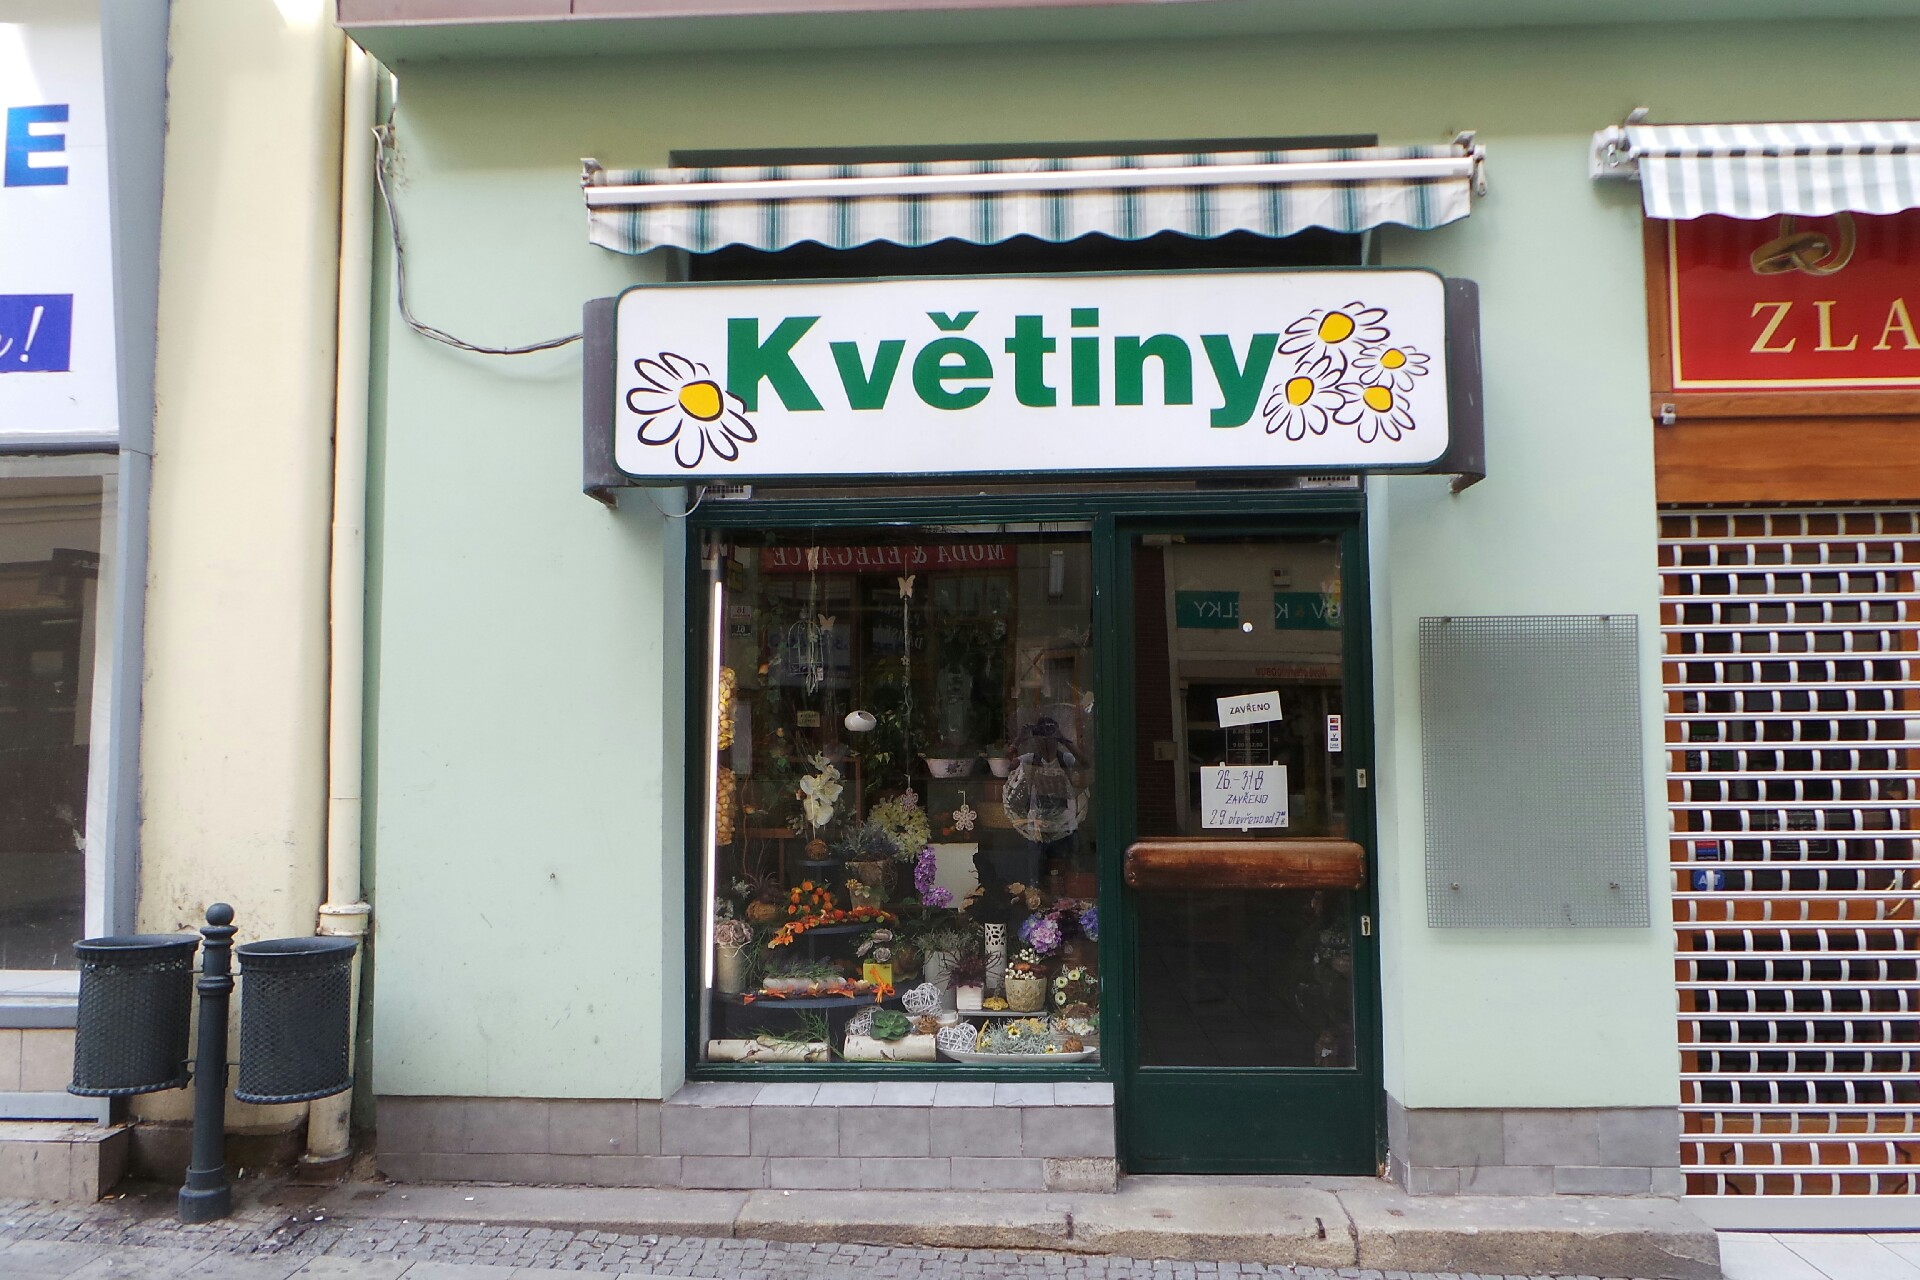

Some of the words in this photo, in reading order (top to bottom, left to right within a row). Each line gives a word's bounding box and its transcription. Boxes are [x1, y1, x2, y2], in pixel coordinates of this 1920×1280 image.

[4, 104, 69, 187] E
[1750, 298, 1920, 354] ZLA
[726, 308, 1281, 428] Květiny
[1229, 702, 1271, 715] ZAVŘENO
[1225, 791, 1269, 804] ZAVŘENO
[1698, 873, 1721, 886] AT
